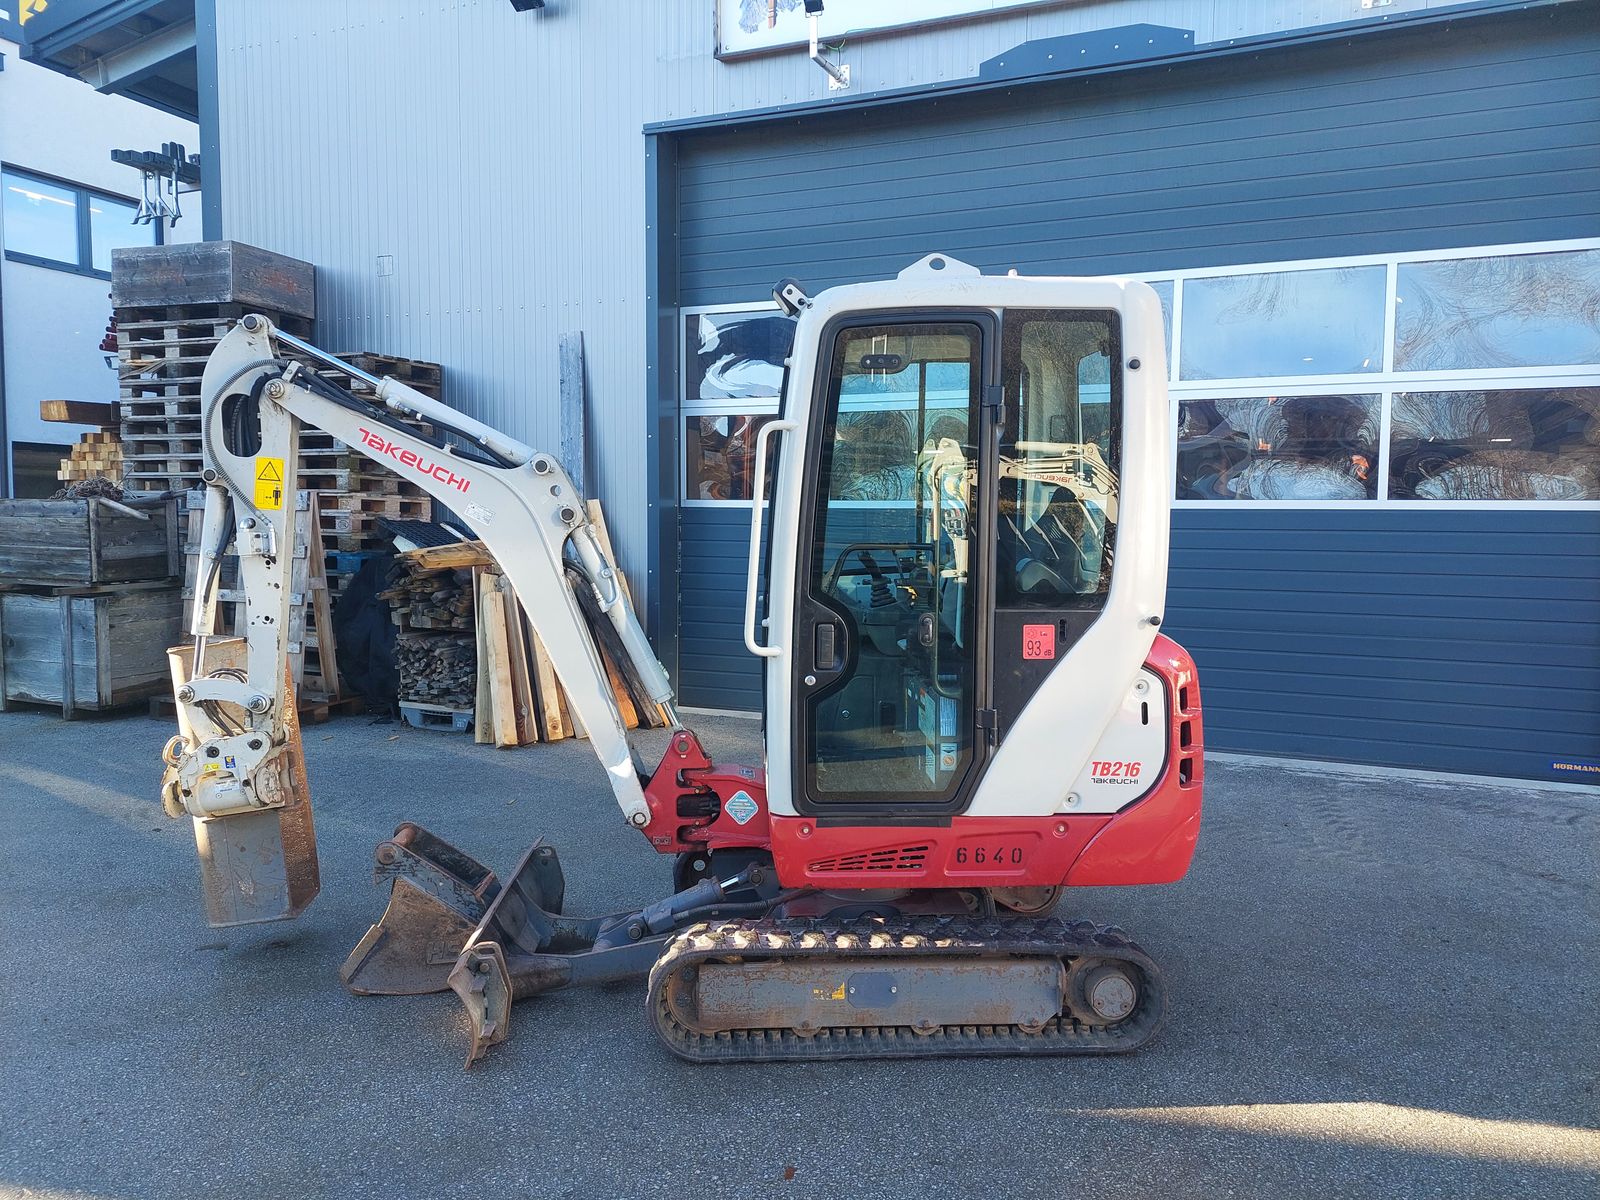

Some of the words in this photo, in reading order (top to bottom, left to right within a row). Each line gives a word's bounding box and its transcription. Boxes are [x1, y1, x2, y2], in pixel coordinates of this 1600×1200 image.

[1027, 640, 1042, 656] 93
[1091, 761, 1142, 777] TB216
[956, 847, 1023, 864] 6640
